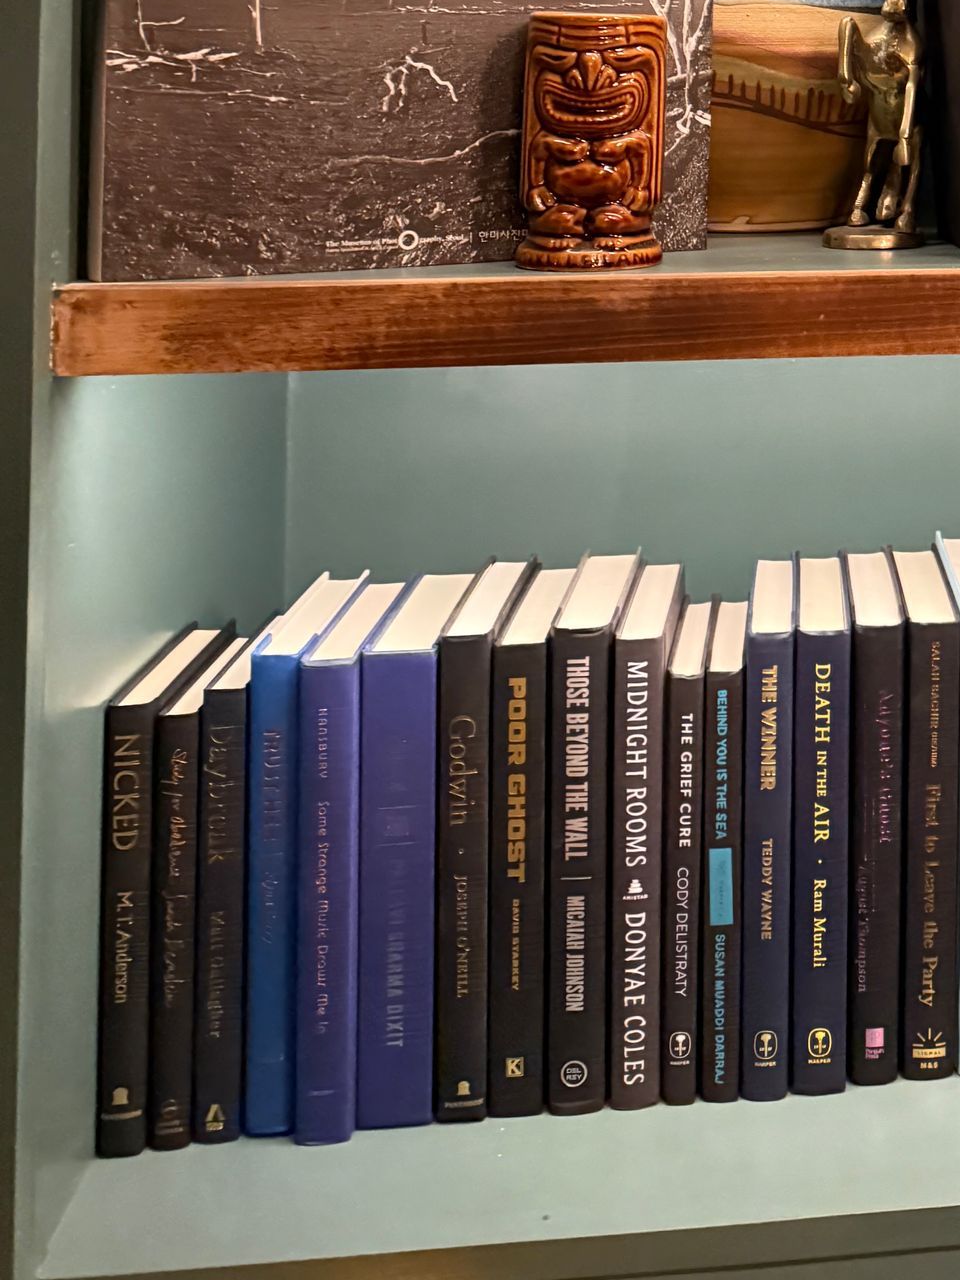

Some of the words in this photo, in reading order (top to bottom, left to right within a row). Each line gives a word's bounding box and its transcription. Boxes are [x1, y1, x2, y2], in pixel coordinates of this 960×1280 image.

[566, 655, 590, 708] THOSE
[760, 665, 778, 702] THE
[814, 663, 831, 743] DEATH
[507, 677, 526, 766] POOR
[625, 661, 649, 778] MIDNIGHT
[680, 713, 694, 746] THE
[716, 689, 729, 735] BEHIND
[565, 712, 590, 776] BEYOND
[716, 738, 729, 765] YOU
[759, 706, 778, 790] WINNER
[815, 751, 828, 766] IN
[565, 781, 589, 812] THE
[680, 750, 694, 797] GRIEF
[715, 784, 728, 810] THE
[716, 769, 728, 780] IS
[815, 769, 828, 797] THE
[506, 774, 526, 883] GHOST
[564, 816, 588, 860] WALL
[624, 787, 648, 867] ROOMS
[679, 802, 693, 848] CURE
[715, 813, 728, 840] SEA
[813, 803, 830, 843] AIR
[760, 838, 773, 885] TEDDY
[675, 867, 690, 910] CODY
[812, 879, 826, 911] Ram
[565, 895, 585, 950] MICAIAH
[760, 888, 773, 940] WAYNE
[623, 912, 647, 1007] DONYAE
[674, 912, 690, 996] DELISTRATY
[714, 933, 726, 977] SUSAN
[812, 918, 827, 967] Murali
[564, 954, 585, 1012] JOHNSON
[713, 980, 725, 1030] MUADDI
[622, 1015, 646, 1086] COLES
[713, 1034, 725, 1084] DARRAJ
